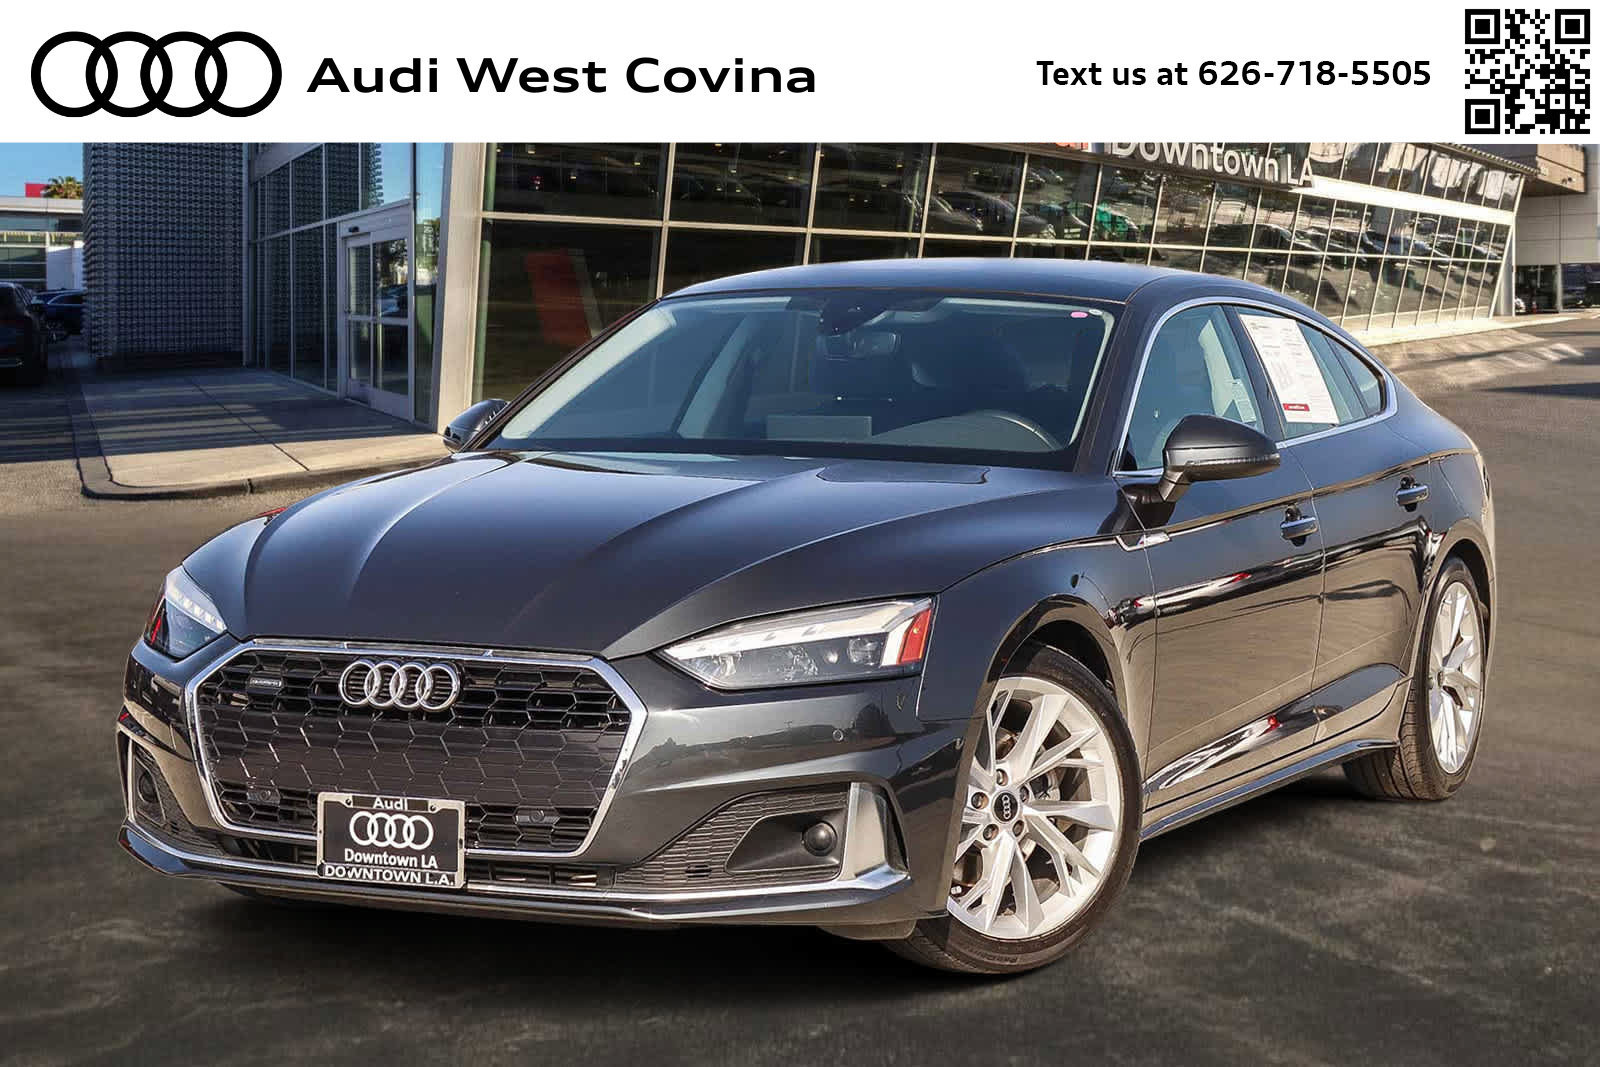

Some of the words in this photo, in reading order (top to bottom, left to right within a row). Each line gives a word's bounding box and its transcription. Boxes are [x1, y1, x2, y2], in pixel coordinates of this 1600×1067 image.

[1287, 153, 1313, 187] LA
[372, 796, 408, 811] Audi
[344, 848, 418, 867] Downtown
[421, 854, 438, 869] LA
[324, 865, 421, 883] DOWNTOWN
[425, 873, 454, 886] L.A.
